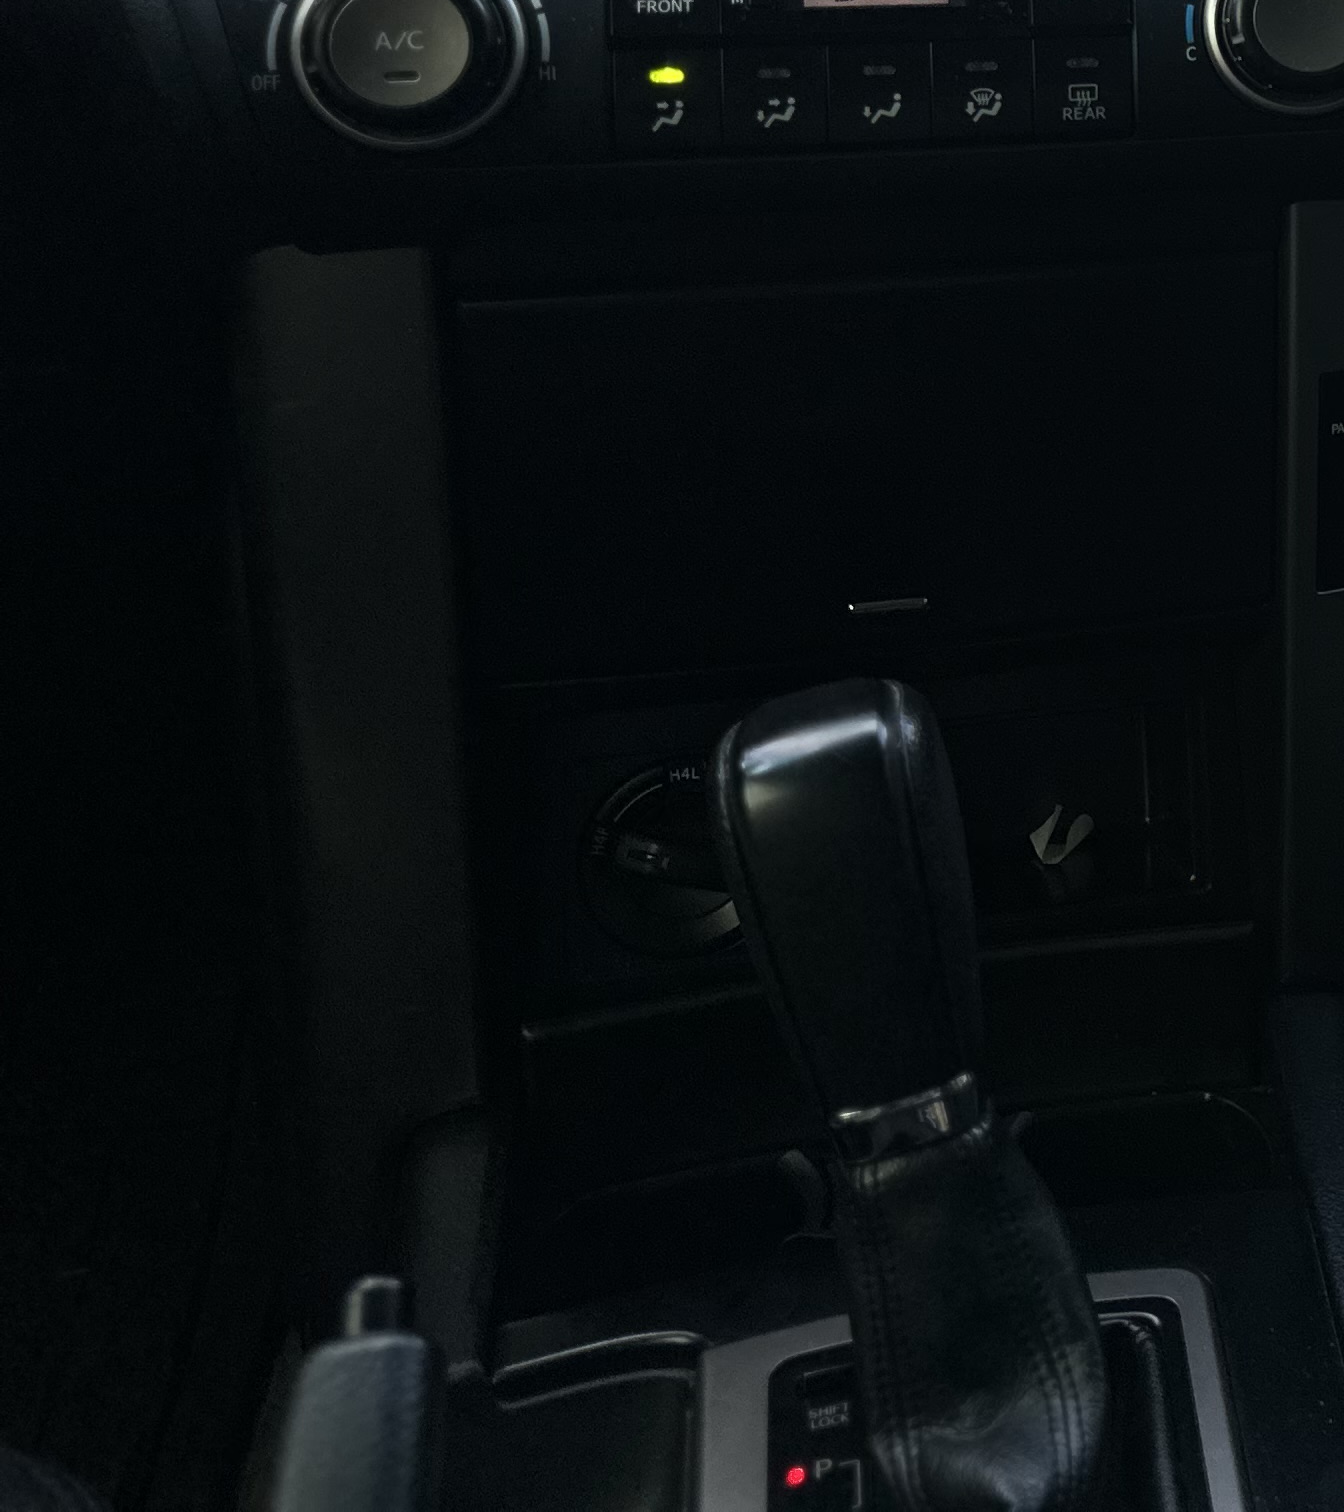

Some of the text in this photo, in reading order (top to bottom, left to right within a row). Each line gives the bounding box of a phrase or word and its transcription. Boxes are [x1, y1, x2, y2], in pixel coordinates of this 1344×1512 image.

[637, 0, 694, 13] FRONT
[375, 30, 425, 51] A/C
[1186, 45, 1197, 62] C
[539, 65, 557, 81] HI
[251, 73, 280, 91] OFF
[1062, 106, 1107, 121] REAR
[669, 767, 701, 783] H4L
[808, 1401, 849, 1419] SHIFT
[810, 1412, 850, 1431] LOCK
[815, 1458, 833, 1480] P
